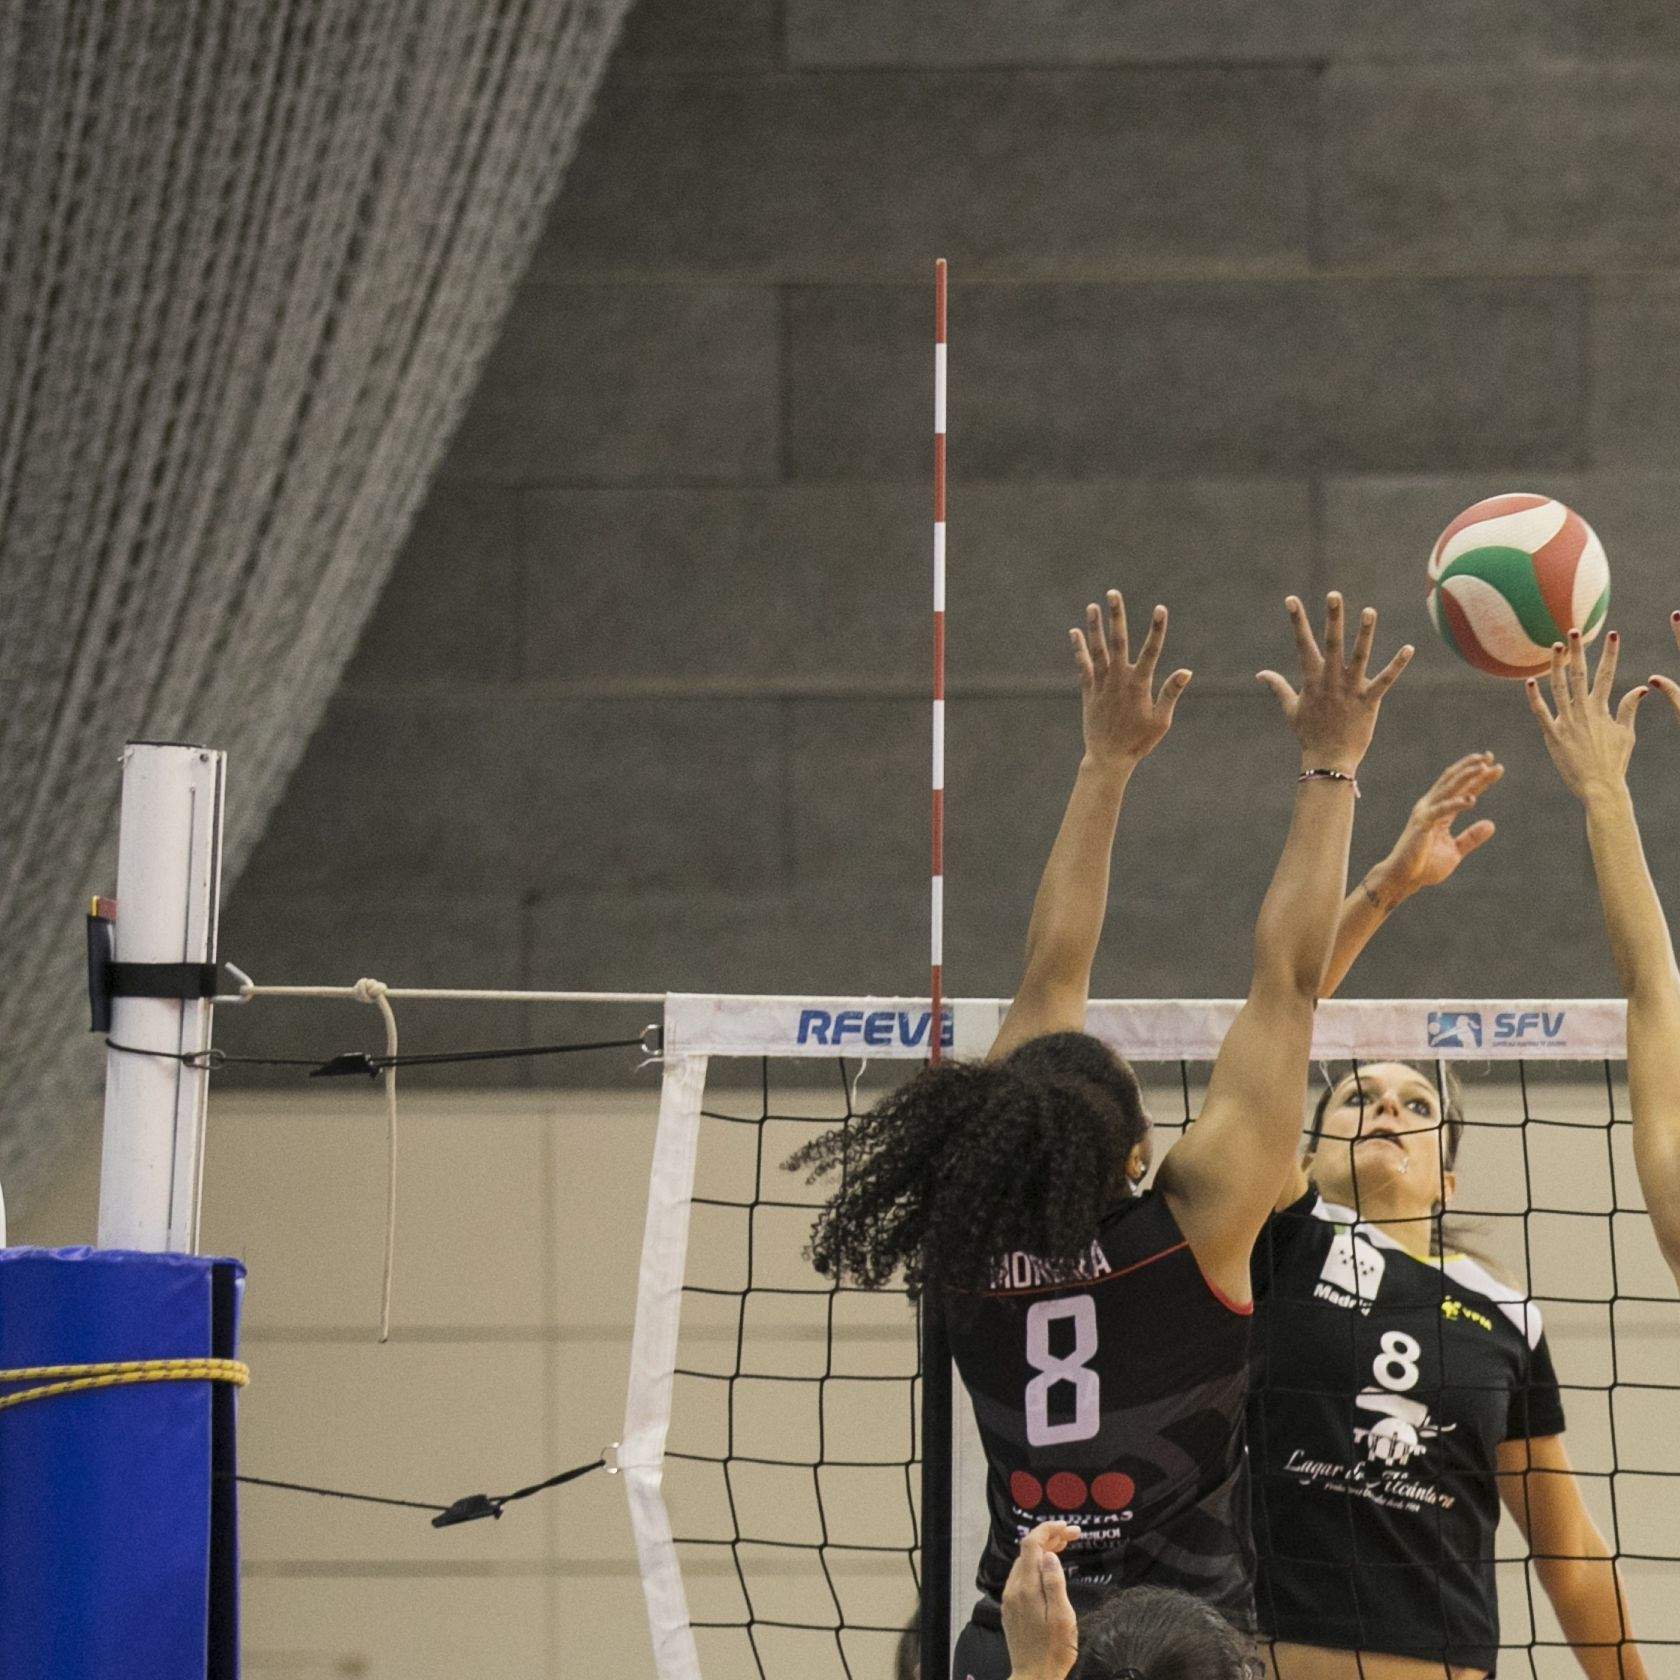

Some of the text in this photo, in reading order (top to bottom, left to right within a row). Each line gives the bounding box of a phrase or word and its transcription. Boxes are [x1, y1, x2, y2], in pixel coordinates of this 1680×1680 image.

[1494, 1012, 1565, 1037] SFV
[1025, 1293, 1099, 1447] 8
[1373, 1330, 1420, 1392] 8
